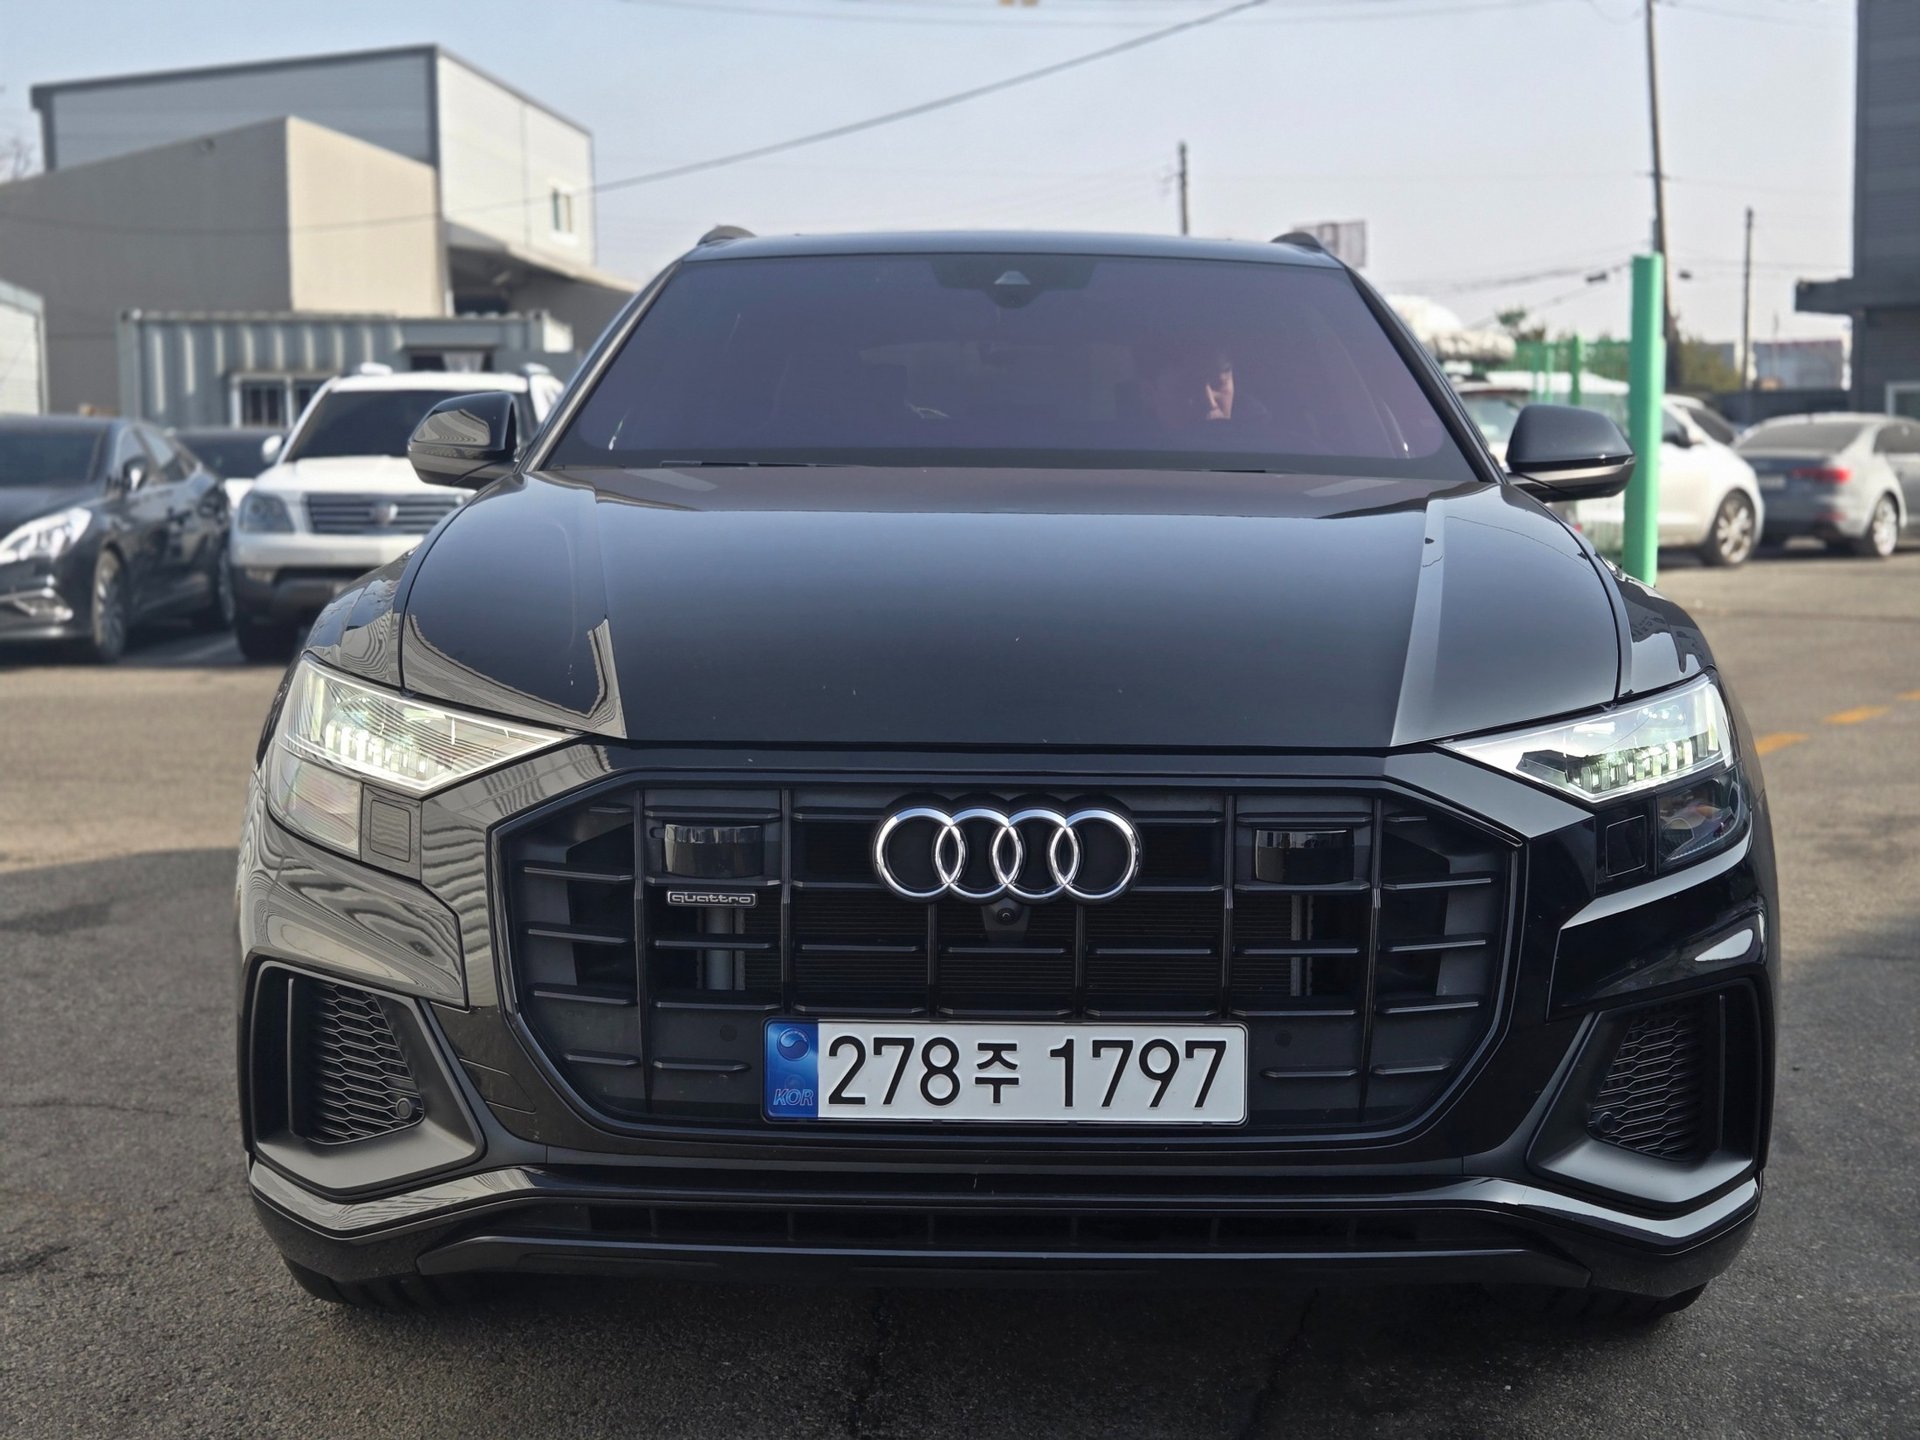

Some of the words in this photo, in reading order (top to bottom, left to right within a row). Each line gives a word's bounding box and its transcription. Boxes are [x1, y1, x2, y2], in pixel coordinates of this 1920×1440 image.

[671, 893, 751, 904] quattro
[828, 1035, 1020, 1106] 278주
[1049, 1038, 1227, 1109] 1797
[773, 1088, 814, 1106] KOR
